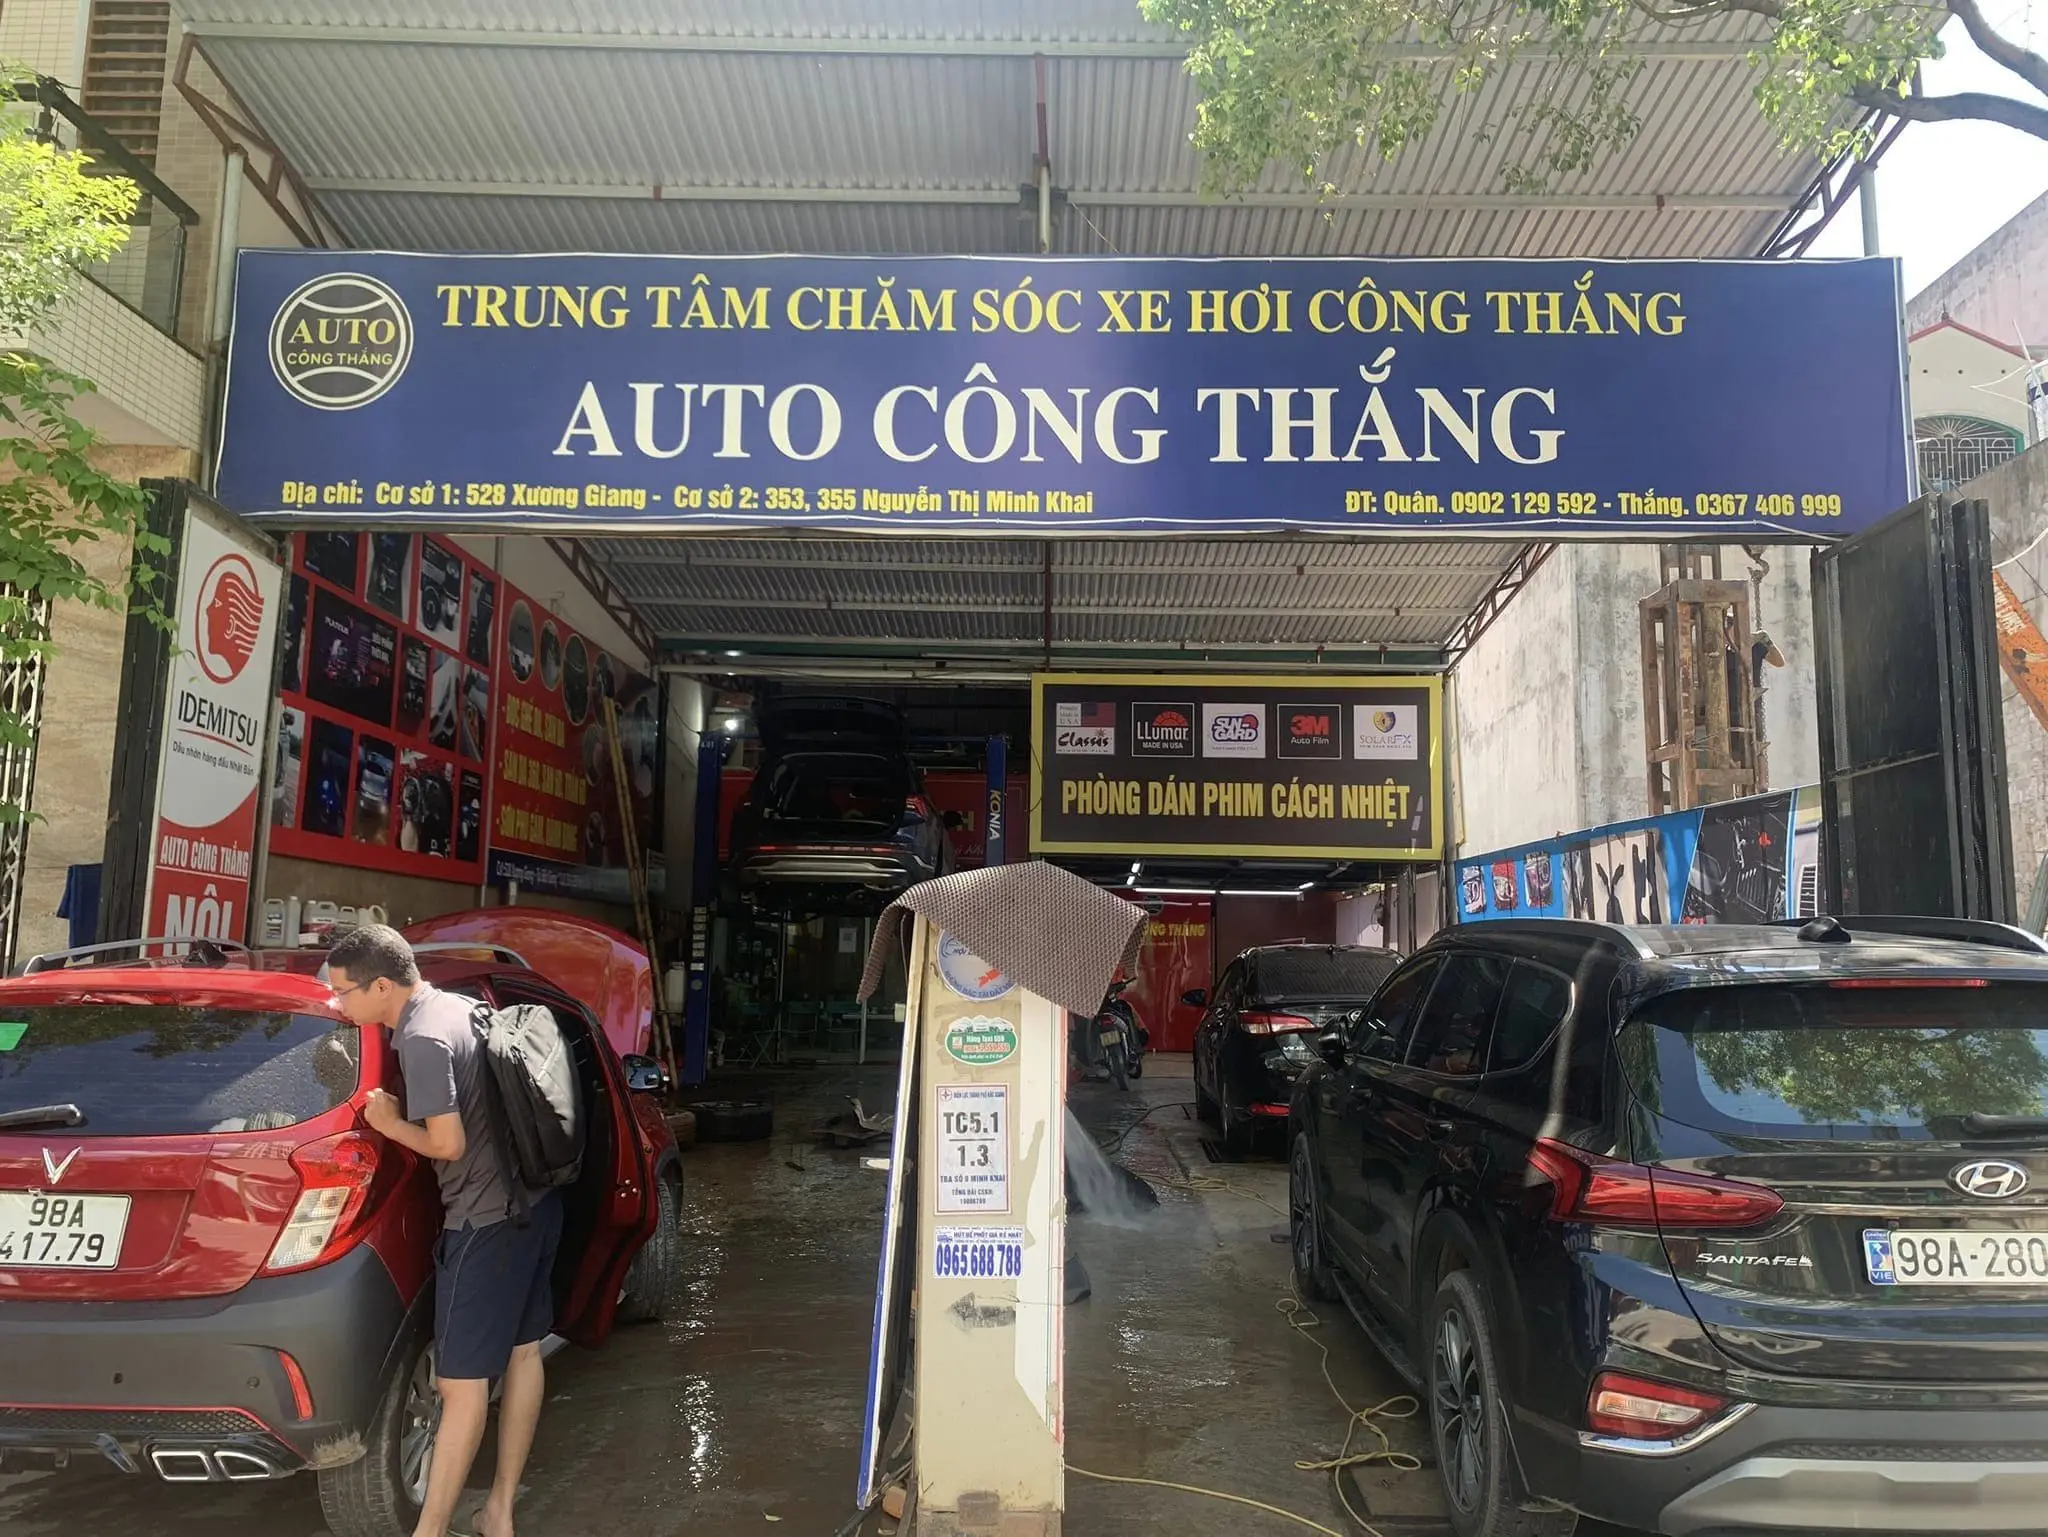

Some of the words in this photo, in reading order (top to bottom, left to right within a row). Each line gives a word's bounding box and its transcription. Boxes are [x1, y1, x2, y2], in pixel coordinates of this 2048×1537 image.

[437, 284, 630, 329] TRUNG
[647, 273, 771, 330] TÂM
[786, 276, 957, 332] CHĂM
[971, 276, 1082, 334] SÓC
[1098, 289, 1173, 333] XE
[1187, 283, 1293, 333] HƠI
[1308, 277, 1471, 335] CÔNG
[1486, 269, 1687, 337] THẮNG
[288, 318, 396, 346] AUTO
[286, 348, 334, 366] CÔNG
[336, 346, 394, 366] THẮNG
[552, 380, 842, 462] AUTO
[872, 362, 1169, 466] CÔNG
[1197, 346, 1566, 466] THẮNG
[282, 481, 317, 509] Địa
[323, 478, 363, 506] chỉ:
[376, 483, 403, 507] Cơ
[407, 482, 436, 507] sở
[442, 484, 461, 507] 1:
[466, 484, 506, 507] 528
[511, 484, 580, 510] Xương
[584, 485, 647, 511] Giang
[674, 486, 702, 509] Cơ
[707, 484, 735, 510] sở
[739, 487, 759, 510] 2:
[766, 488, 811, 514] 353,
[817, 488, 857, 511] 355
[862, 485, 942, 515] Nguyễn
[948, 489, 979, 516] Thị
[986, 490, 1039, 513] Minh
[1045, 491, 1093, 513] Khai
[1345, 491, 1377, 514] ĐT:
[1383, 489, 1445, 515] Quân.
[1451, 491, 1505, 515] 0902
[1511, 491, 1551, 515] 129
[1556, 492, 1597, 516] 592
[1617, 487, 1690, 518] Thắng.
[1696, 493, 1747, 516] 0367
[1755, 494, 1795, 517] 406
[1801, 494, 1842, 518] 999
[178, 690, 258, 747] IDEMITSU
[1137, 721, 1189, 740] LLumar
[1290, 715, 1330, 736] 3M
[1142, 741, 1161, 749] MADE
[1170, 742, 1184, 750] USA
[1213, 728, 1256, 741] GARD
[1290, 736, 1311, 746] Auto
[1312, 736, 1330, 746] Film
[1061, 772, 1141, 816] PHÒNG
[1148, 775, 1197, 817] DÁN
[1203, 782, 1264, 818] PHIM
[1271, 776, 1334, 819] CÁCH
[1341, 778, 1410, 828] NHIỆT
[160, 835, 189, 868] AUTO
[190, 836, 218, 873] CÔNG
[219, 839, 249, 878] THẮNG
[943, 1111, 999, 1134] TC5.1
[957, 1144, 989, 1167] 1.3
[28, 1198, 84, 1228] 98A
[936, 1244, 1022, 1277] 0965.688.788
[1871, 1271, 1894, 1280] VIE
